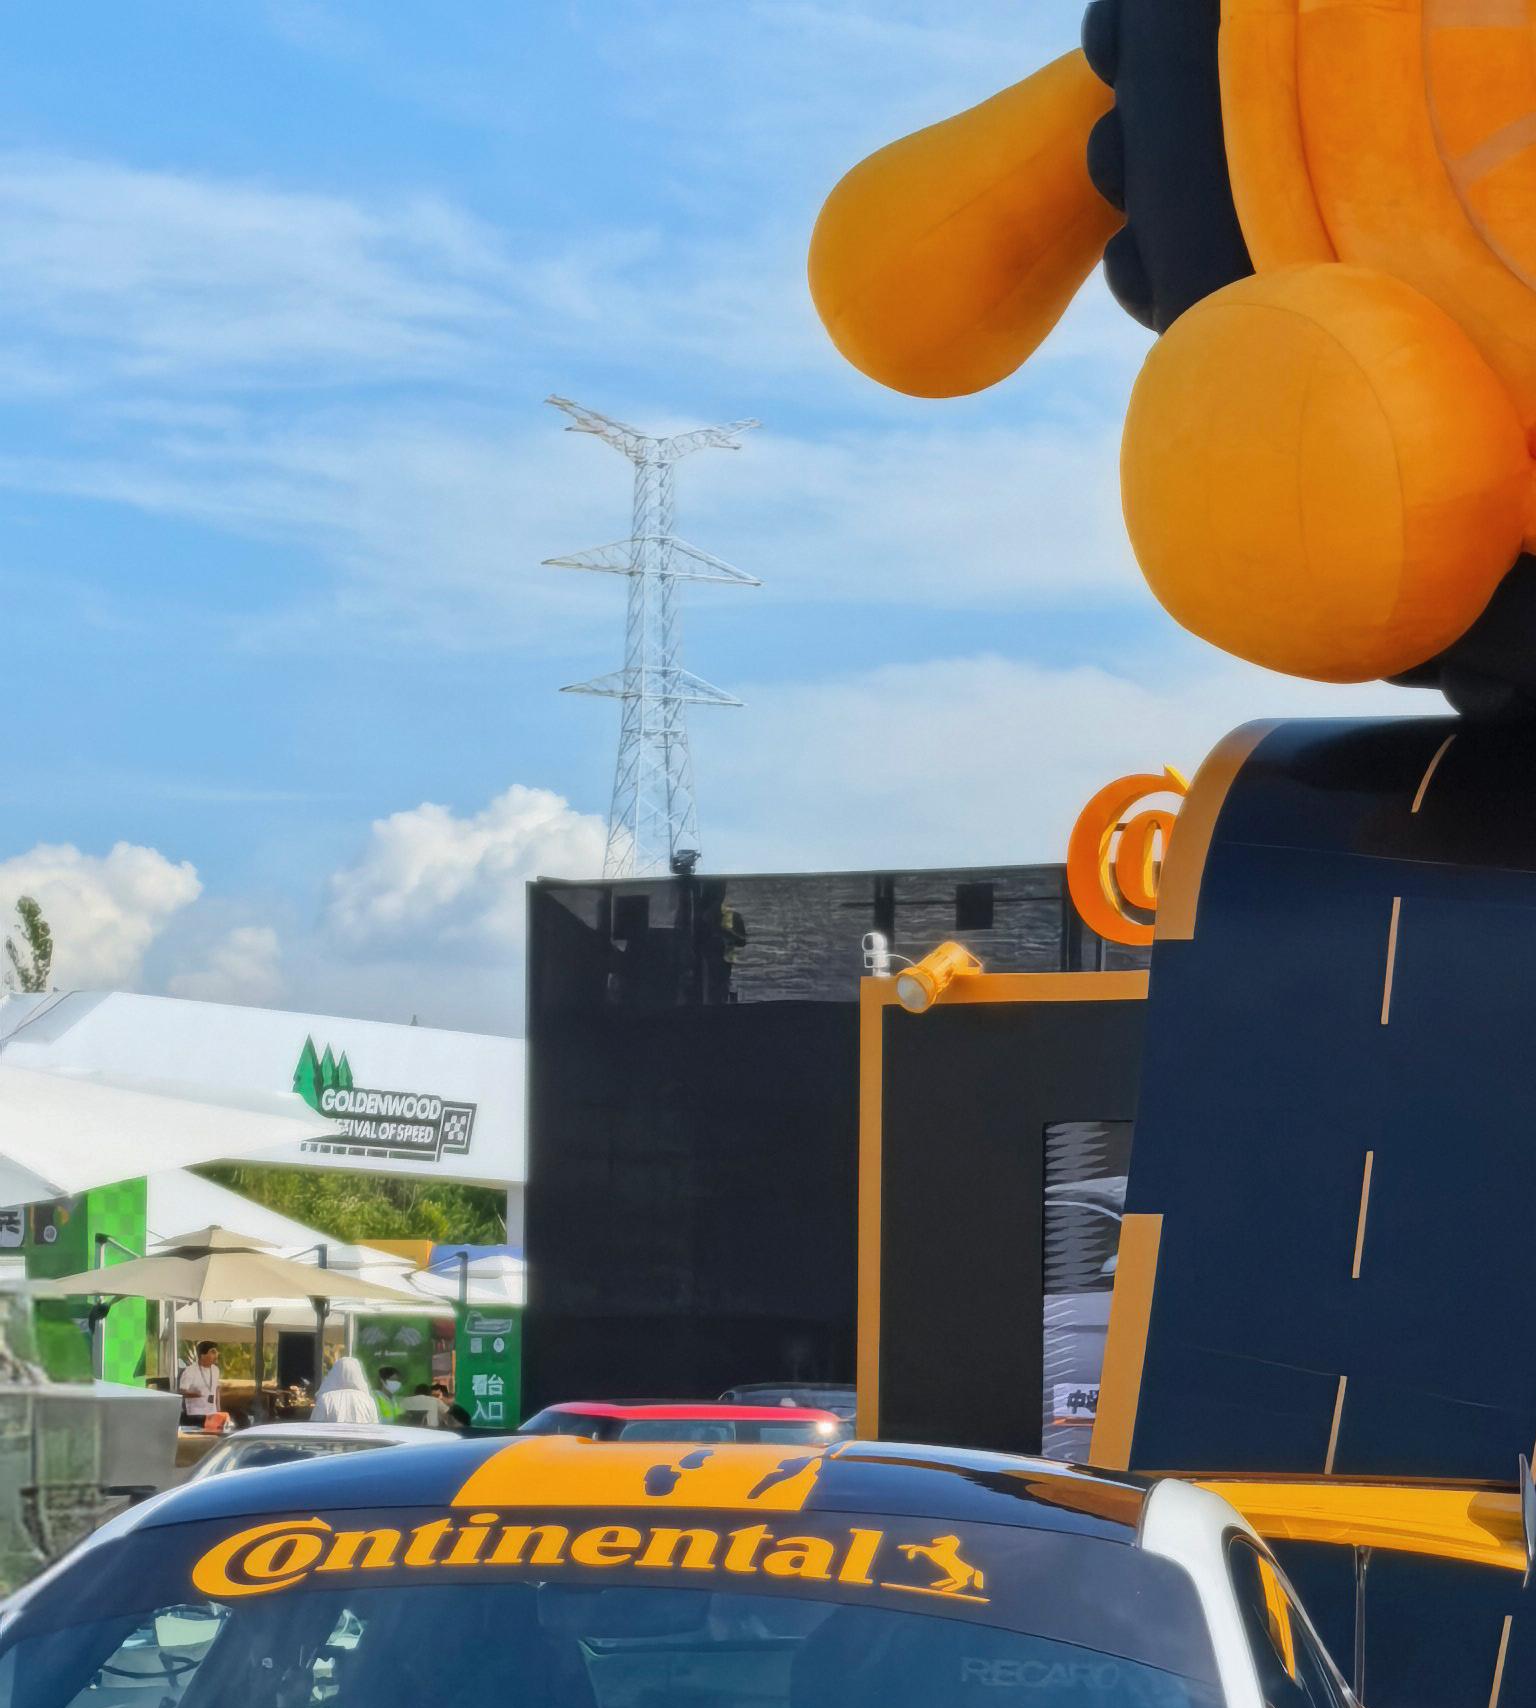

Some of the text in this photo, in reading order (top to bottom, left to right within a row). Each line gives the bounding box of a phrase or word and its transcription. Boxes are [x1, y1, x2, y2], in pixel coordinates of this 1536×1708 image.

[321, 1088, 442, 1120] GOLDENWOOD
[378, 1122, 396, 1140] OF
[396, 1123, 434, 1143] SPEED
[471, 1400, 504, 1420] 入口
[191, 1512, 883, 1597] Continental
[960, 1656, 1120, 1689] RECARO
